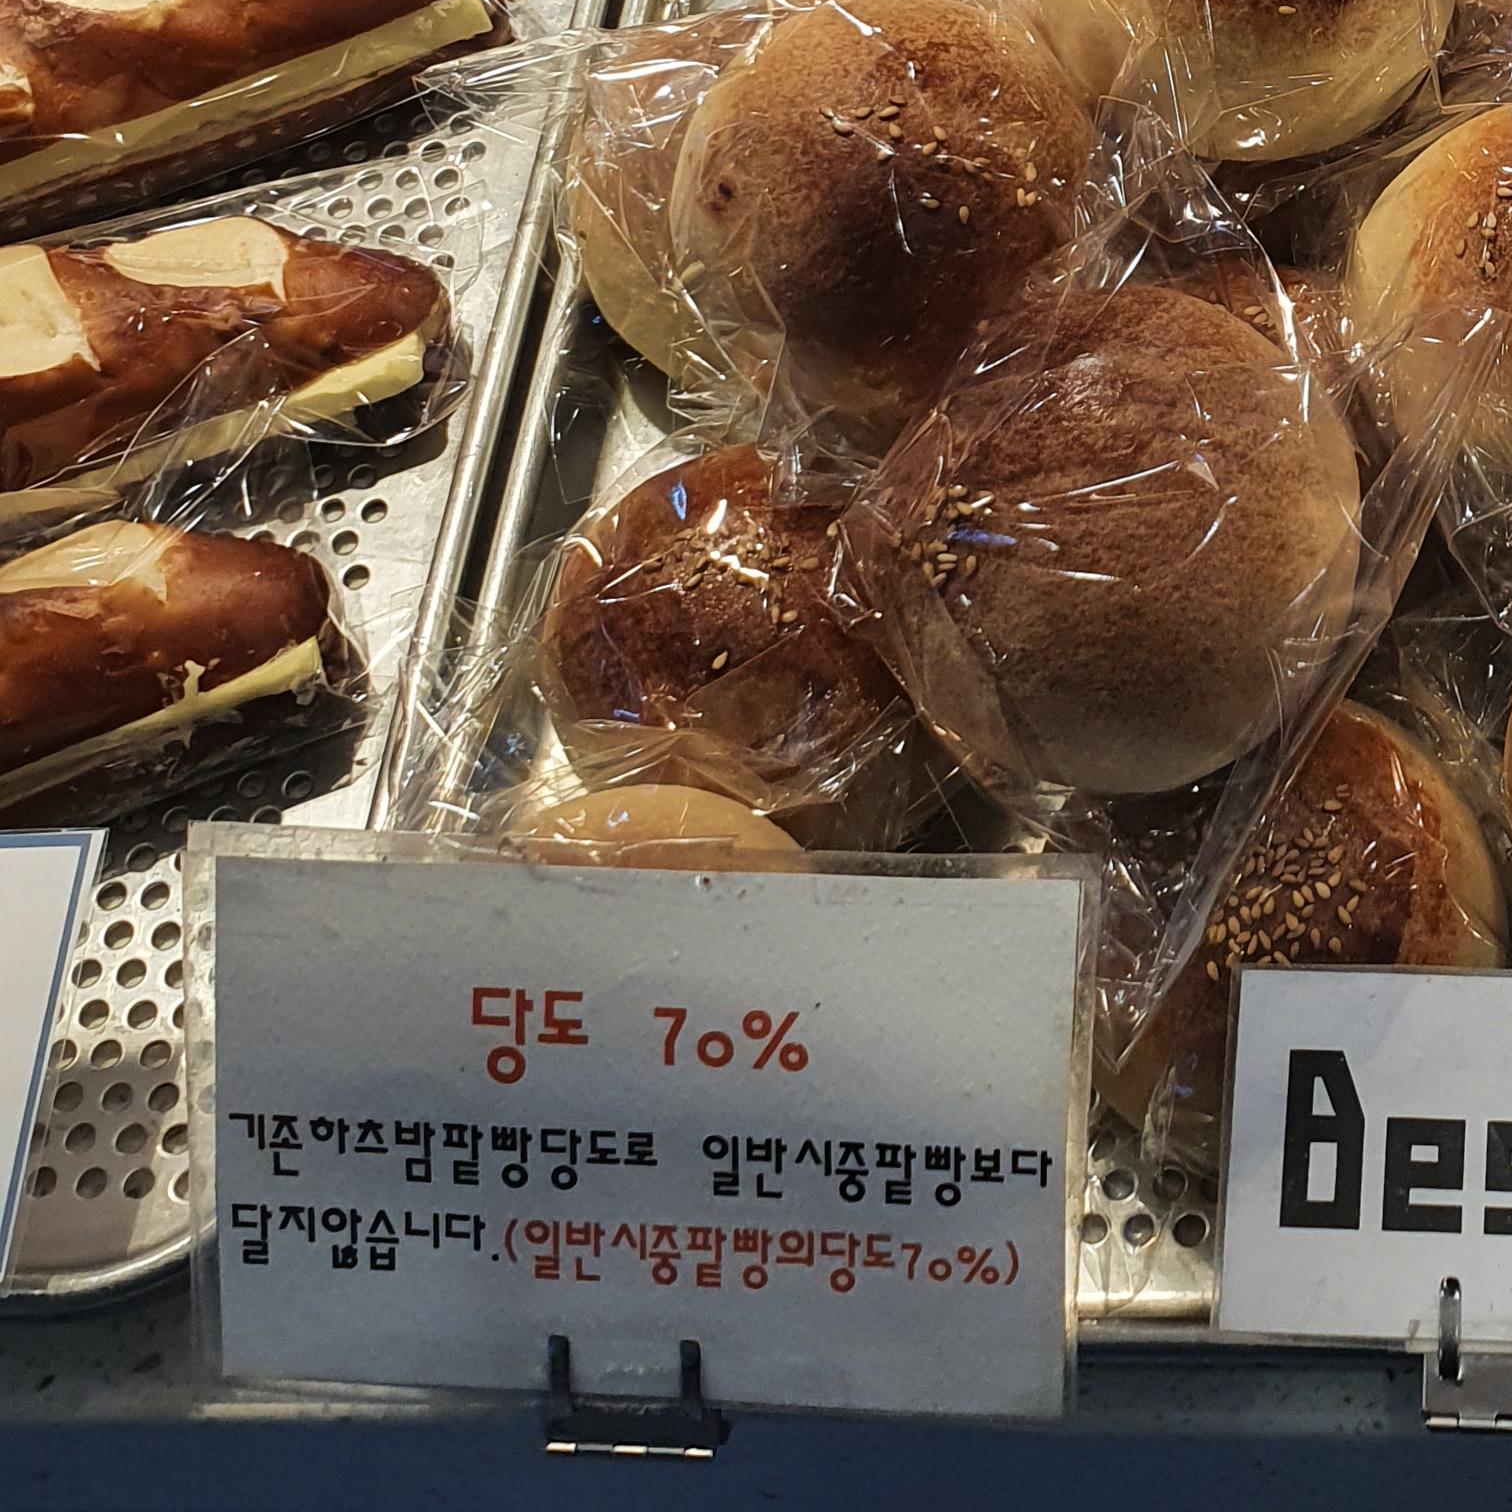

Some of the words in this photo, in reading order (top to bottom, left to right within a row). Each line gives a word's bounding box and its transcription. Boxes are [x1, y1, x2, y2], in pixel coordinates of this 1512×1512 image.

[470, 985, 589, 1085] 당도
[652, 1006, 811, 1072] 70%
[228, 1112, 659, 1190] 기존하츠밤팥빵당도로
[701, 1133, 1054, 1208] 일반시중팥빵보다
